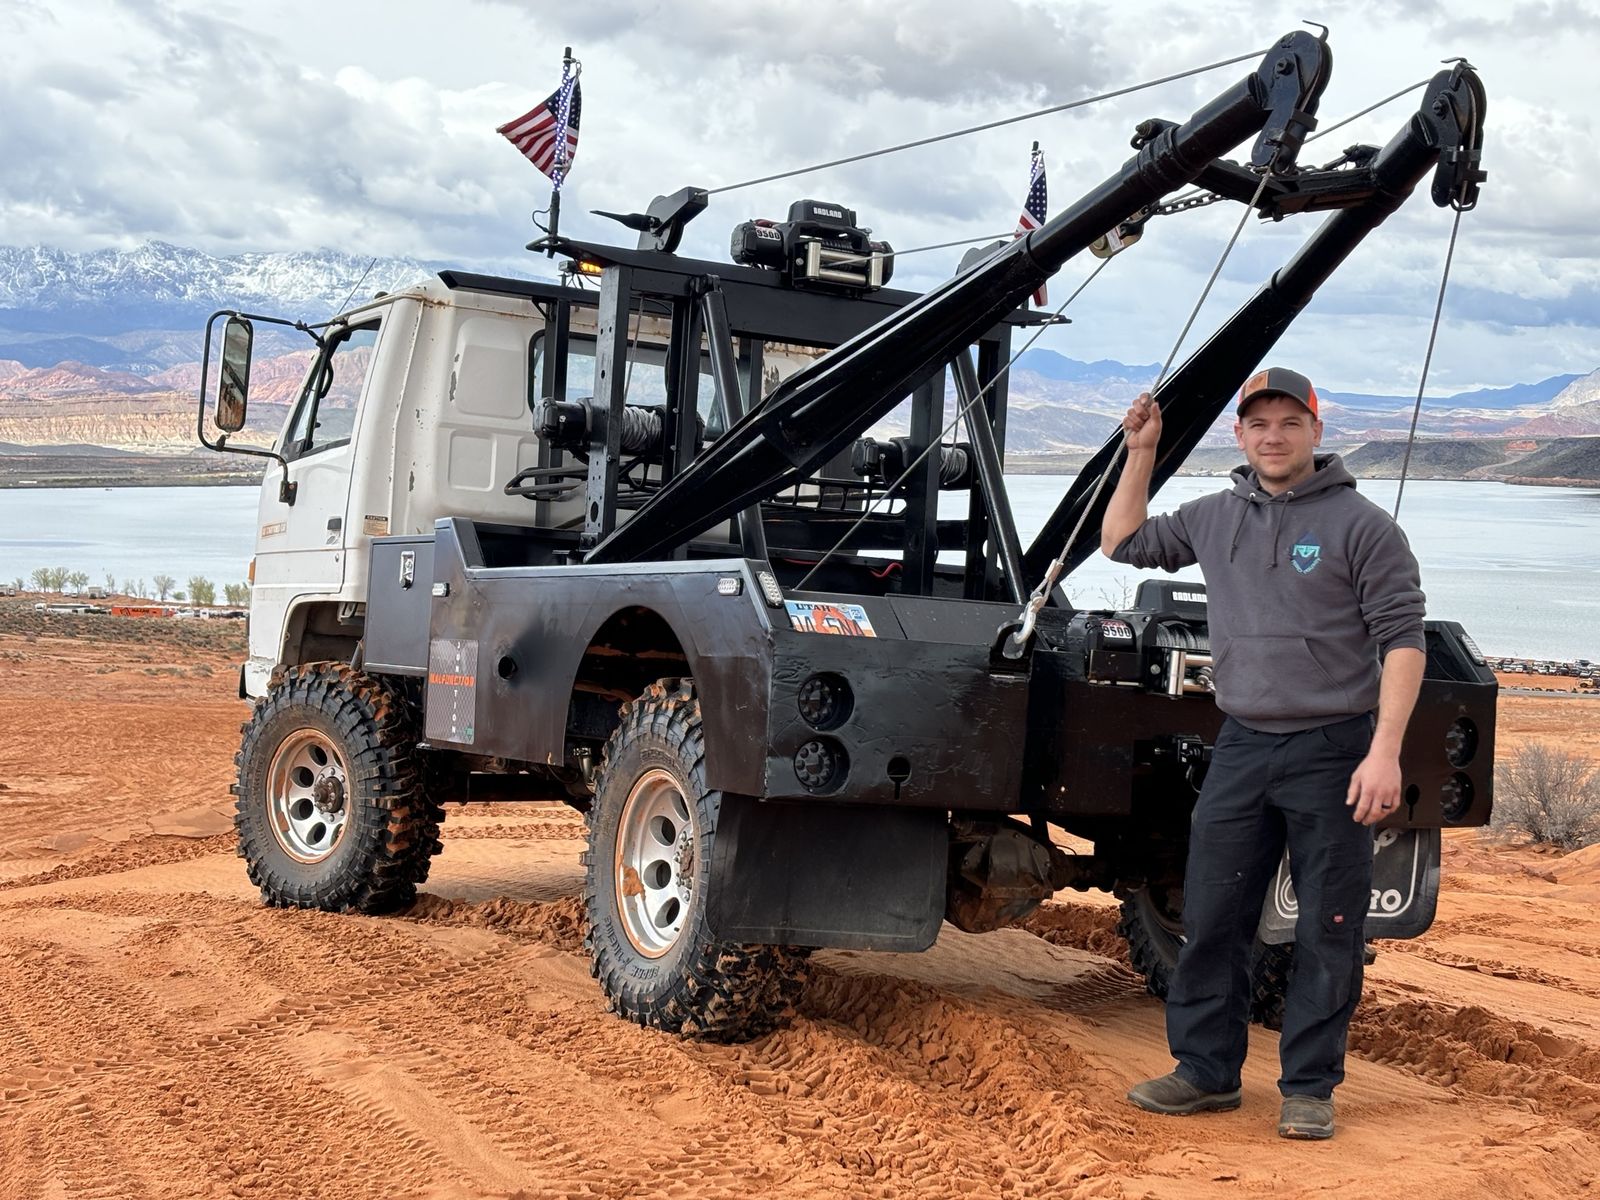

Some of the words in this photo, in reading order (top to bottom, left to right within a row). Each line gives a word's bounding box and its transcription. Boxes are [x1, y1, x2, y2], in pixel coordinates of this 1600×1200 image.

[813, 207, 842, 218] BADLAND
[756, 229, 780, 239] 9500
[1172, 591, 1207, 602] BADLAND
[795, 603, 831, 612] UTAH
[1104, 626, 1130, 637] 9500
